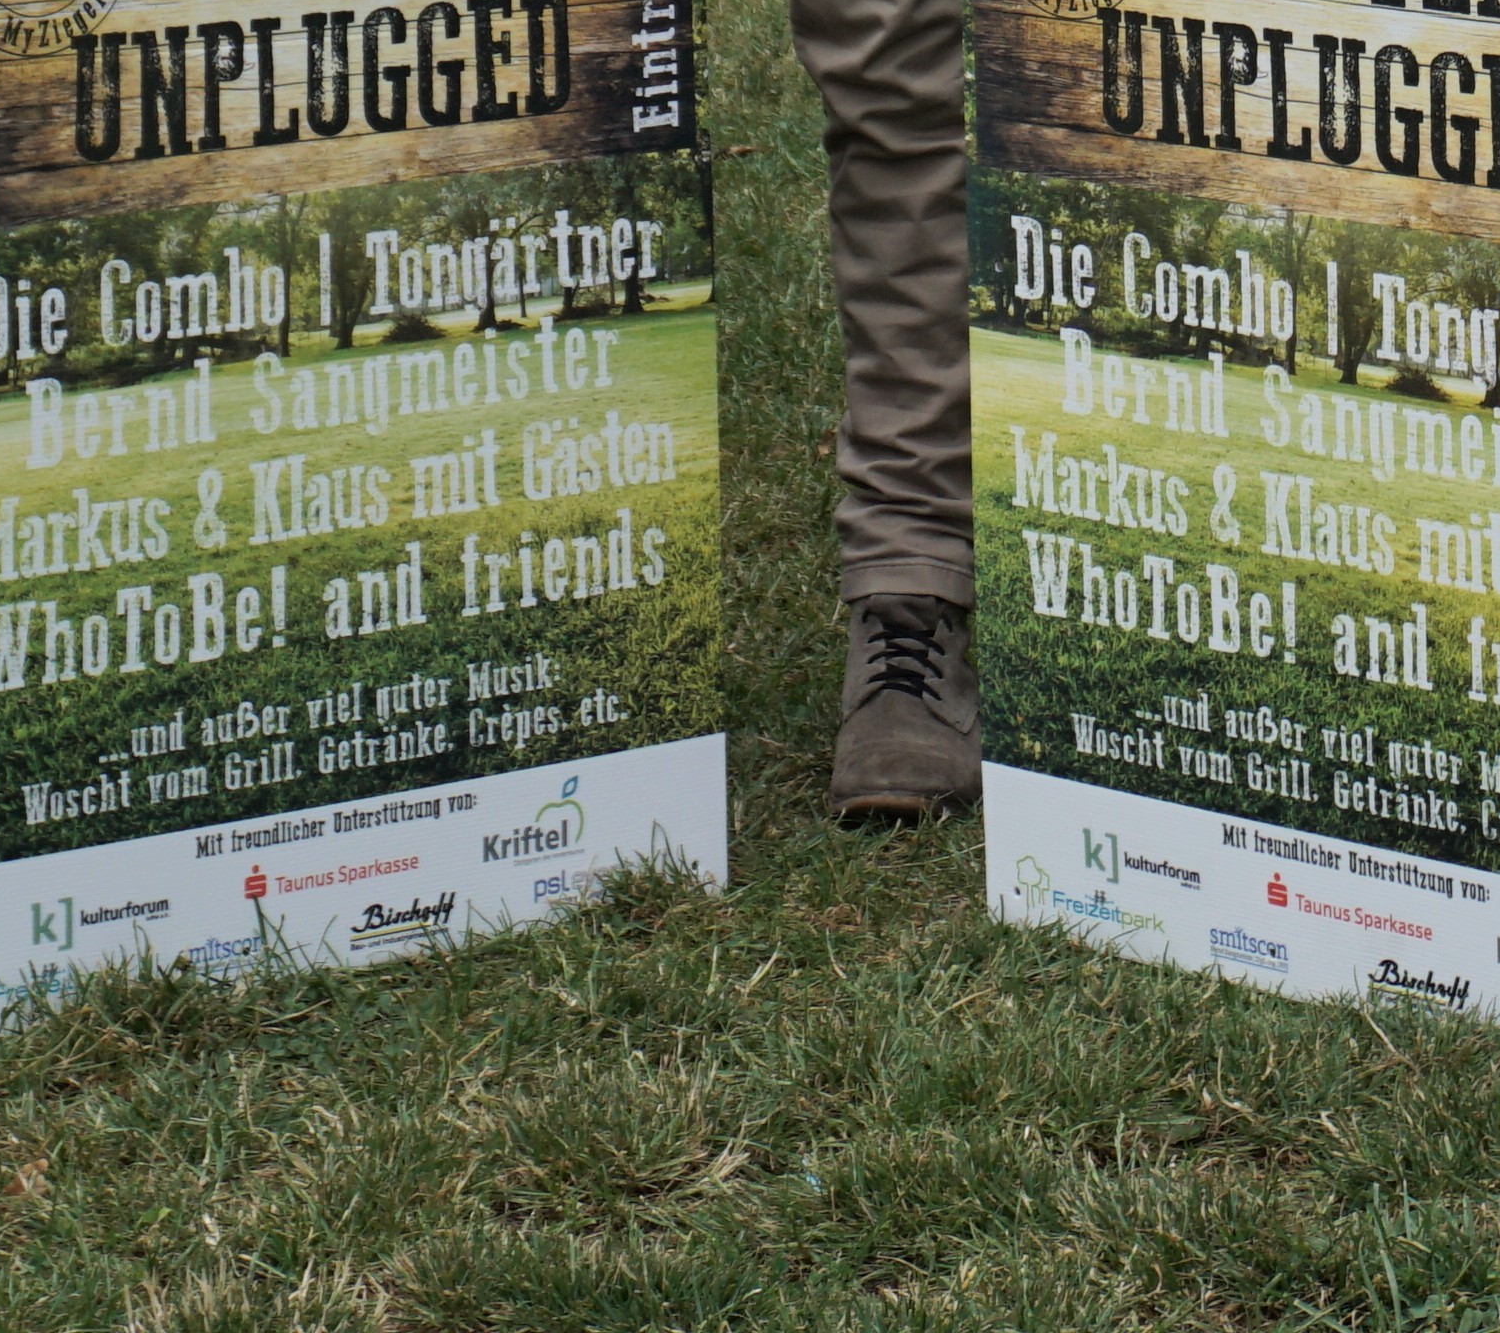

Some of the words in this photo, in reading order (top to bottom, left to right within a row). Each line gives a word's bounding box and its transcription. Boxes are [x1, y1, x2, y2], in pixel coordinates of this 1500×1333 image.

[99, 245, 285, 347] Combo
[366, 208, 663, 315] Tongärtner
[1060, 323, 1230, 444] Bernd
[192, 467, 227, 551] &
[248, 455, 391, 545] Klaus
[410, 427, 500, 519] mit
[522, 409, 676, 503] Gästen
[1009, 424, 1190, 541] Markus
[1209, 461, 1239, 546] &
[1259, 468, 1397, 580] Klaus
[21, 769, 131, 827] Woscht
[147, 763, 209, 805] vom
[580, 685, 628, 728] etc.
[482, 819, 568, 863] Kriftel
[1123, 850, 1200, 887] kulturforum
[1295, 891, 1350, 924] Taunus
[1354, 906, 1433, 944] Sparkasse
